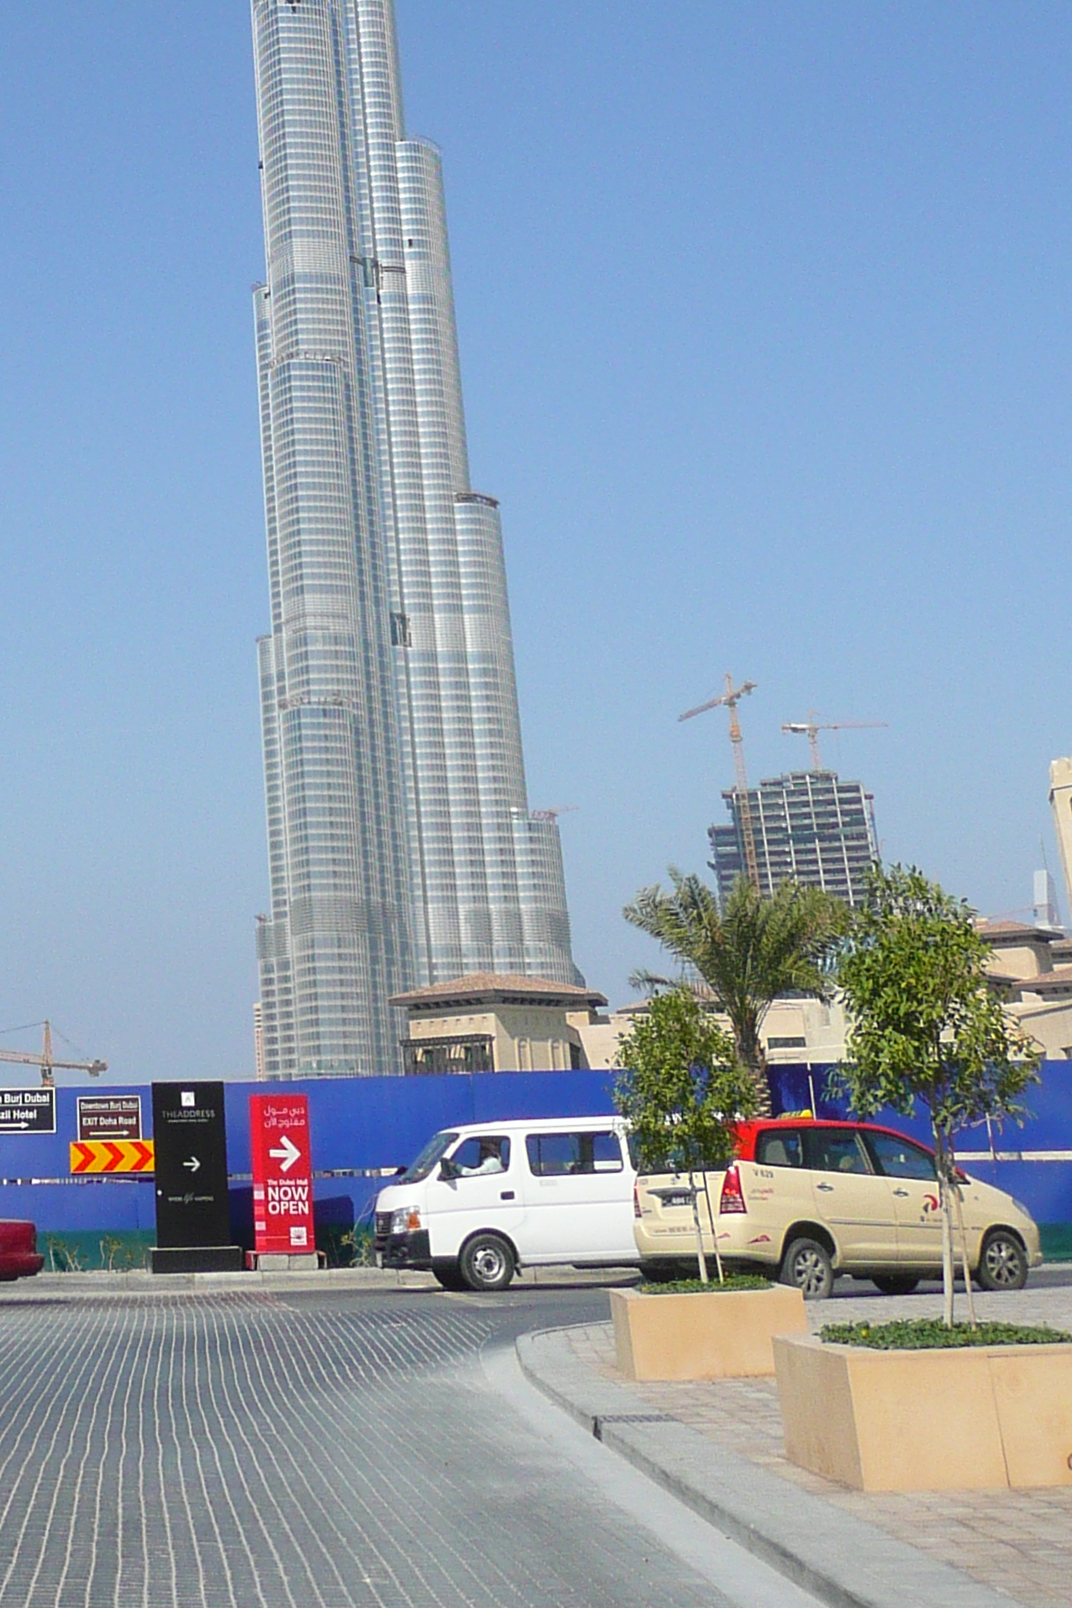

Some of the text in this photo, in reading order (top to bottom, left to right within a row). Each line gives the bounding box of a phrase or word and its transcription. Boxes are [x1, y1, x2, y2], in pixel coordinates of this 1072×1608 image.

[4, 1093, 23, 1105] Burj
[24, 1093, 50, 1103] Dubai
[13, 1109, 37, 1119] Hotel
[82, 1116, 136, 1126] EXIT Doha Road
[268, 1186, 308, 1201] NOW
[268, 1200, 309, 1215] OPEN
